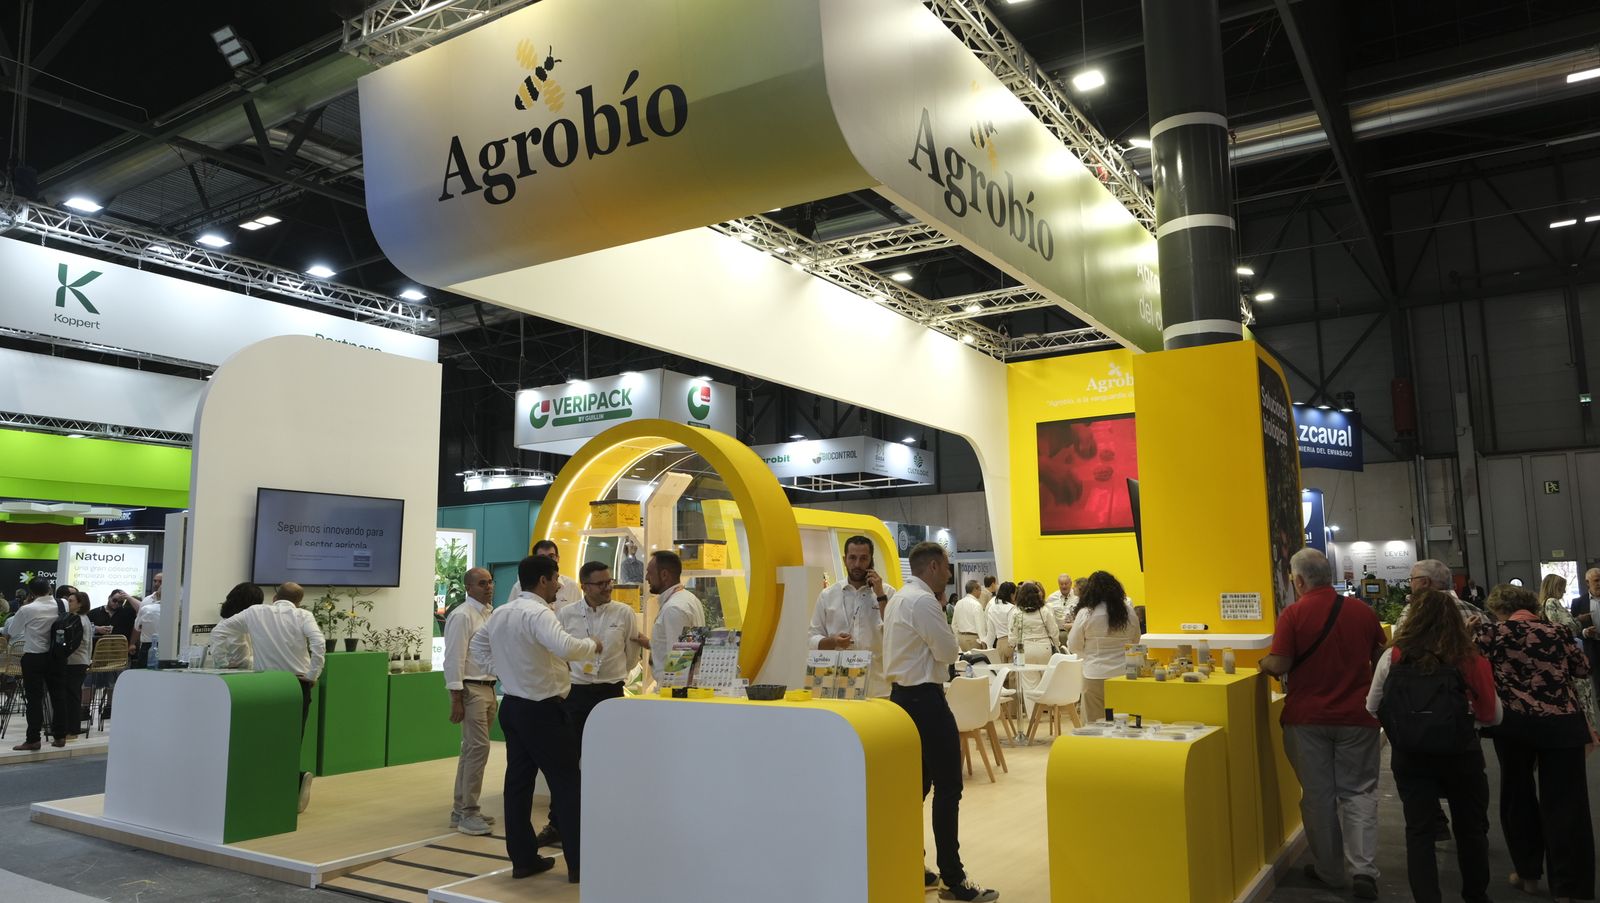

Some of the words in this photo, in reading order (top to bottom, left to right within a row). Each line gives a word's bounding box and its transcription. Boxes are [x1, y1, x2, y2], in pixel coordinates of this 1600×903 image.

[438, 69, 688, 205] Agrobío
[908, 107, 1054, 262] Agrobío
[54, 313, 101, 330] Koppert
[552, 387, 633, 415] VERIPACK
[1296, 425, 1352, 447] zcaval
[1327, 449, 1353, 457] ENVASADO
[277, 521, 320, 534] Seguimos
[323, 524, 364, 536] innovando
[366, 528, 384, 538] para
[75, 551, 125, 563] Natupol
